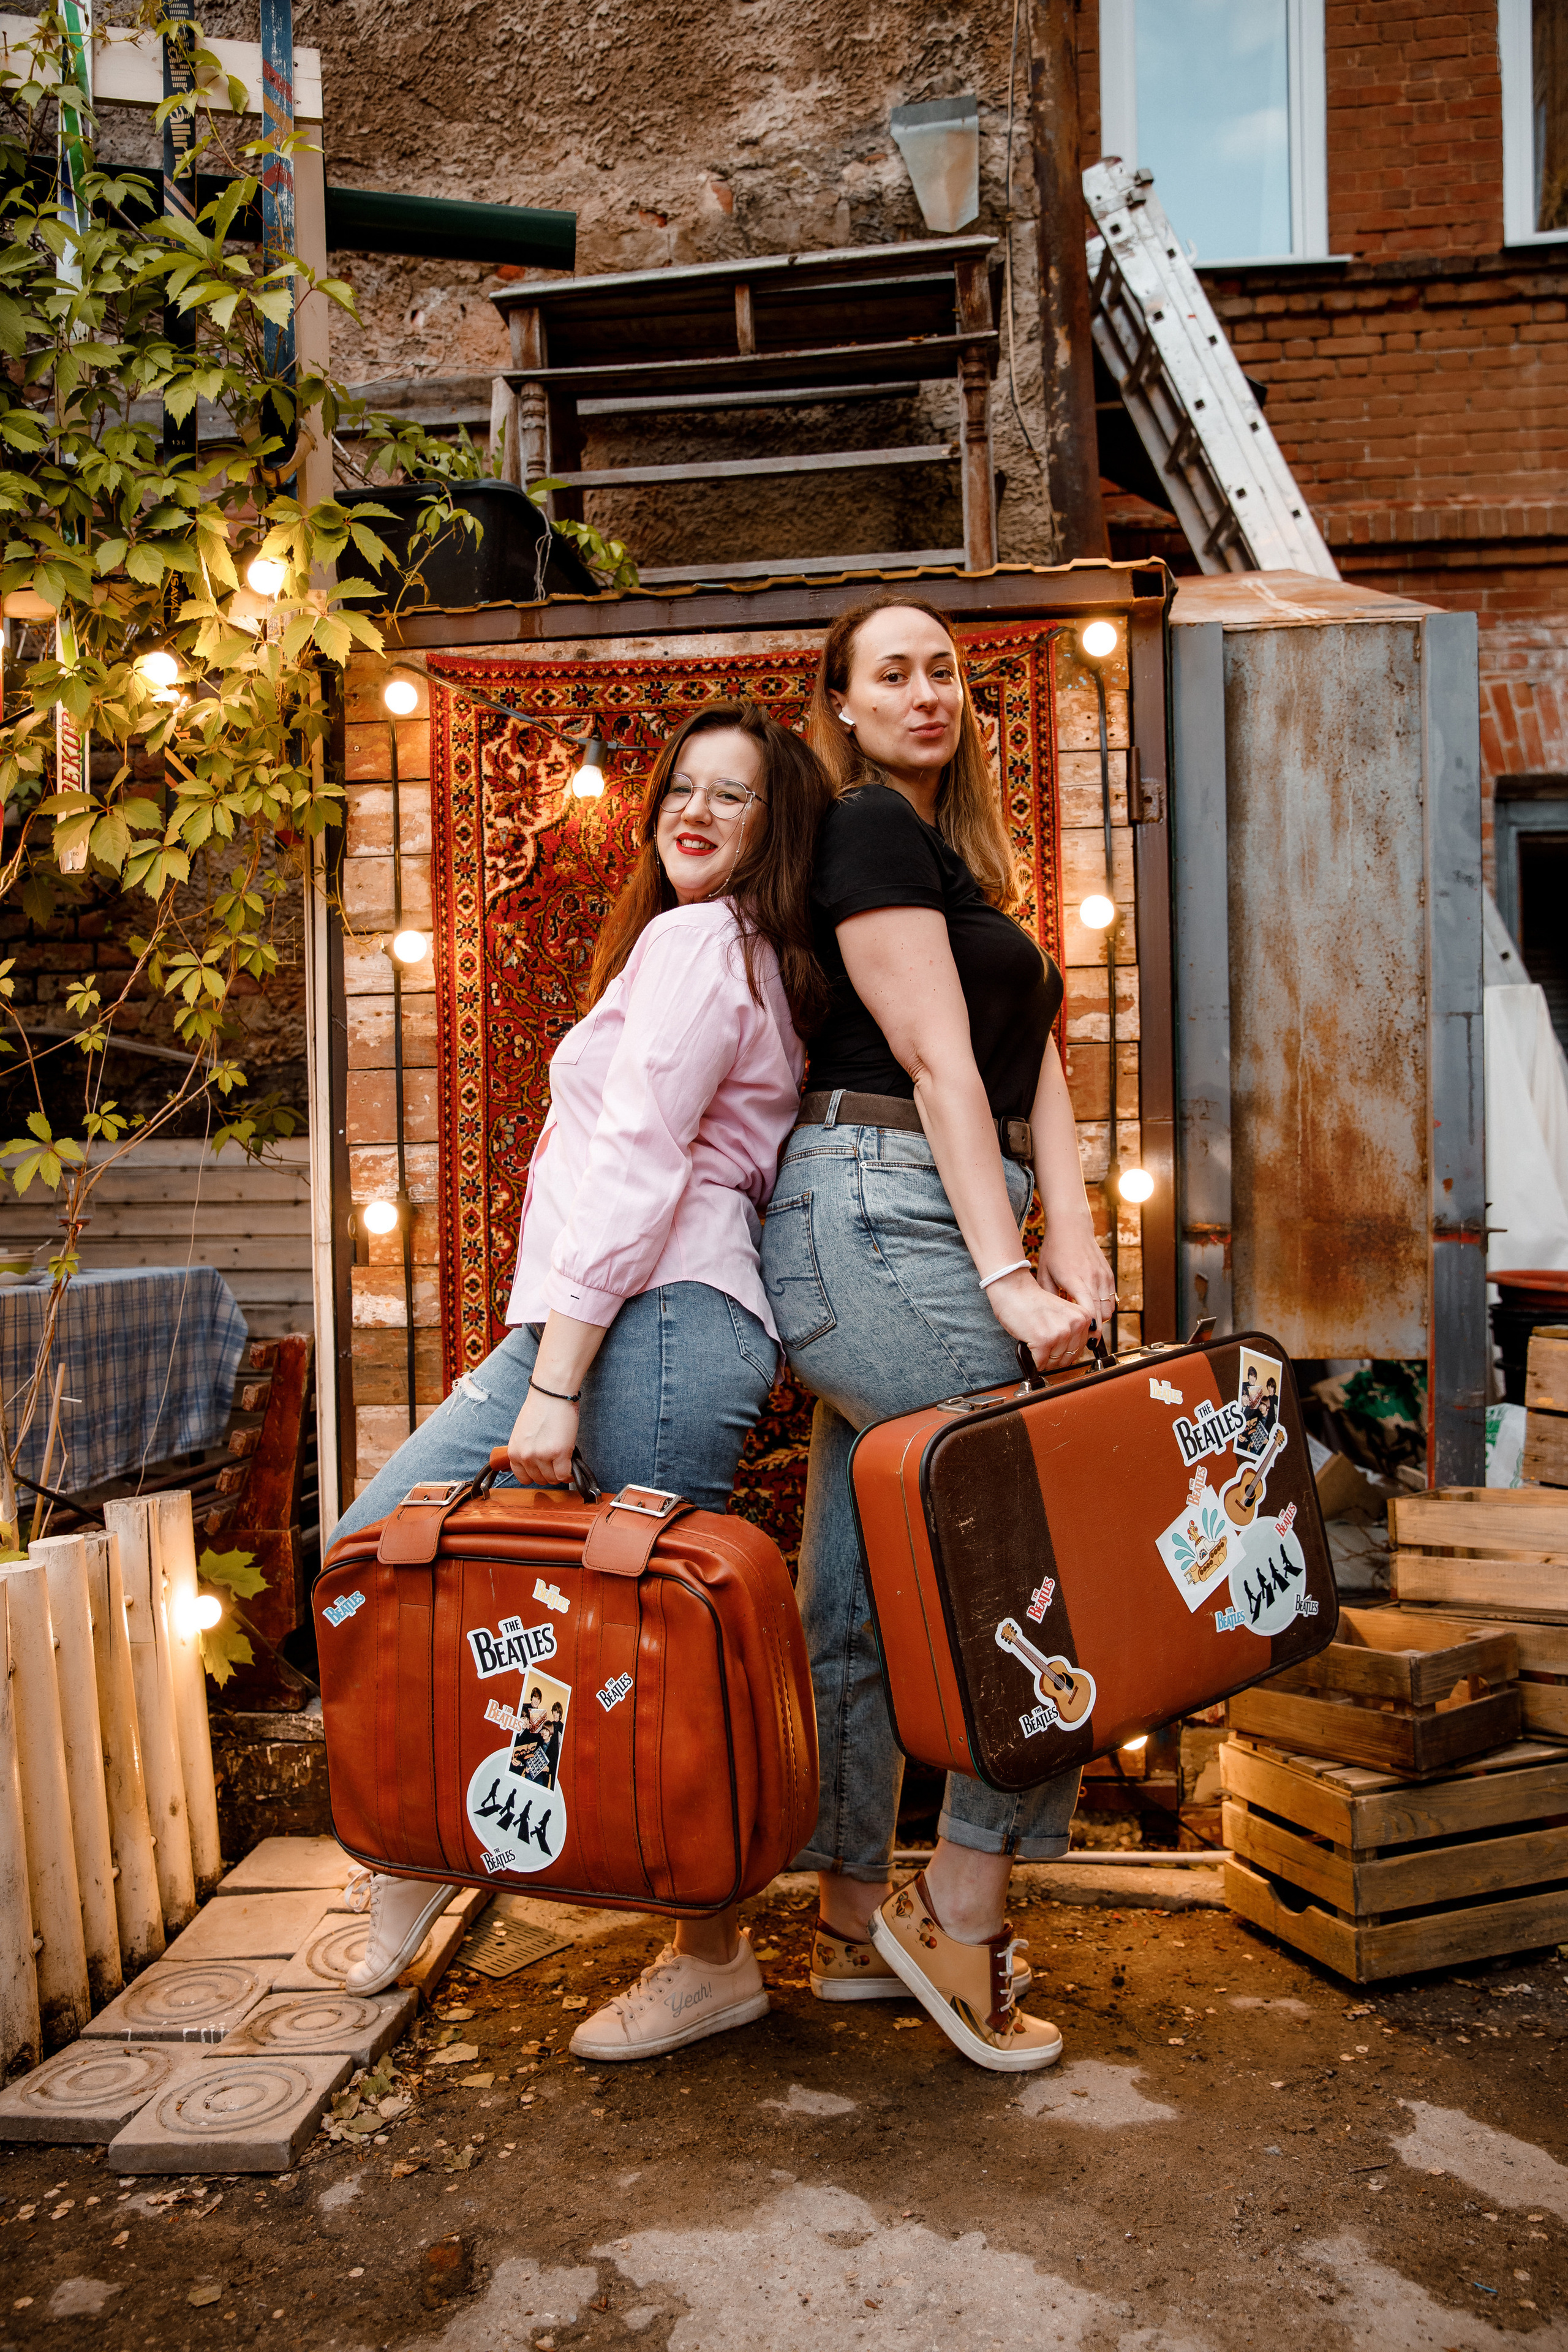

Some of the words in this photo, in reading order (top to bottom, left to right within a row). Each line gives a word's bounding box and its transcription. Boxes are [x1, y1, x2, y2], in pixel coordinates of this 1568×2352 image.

[1198, 1403, 1212, 1418] THE
[1176, 1404, 1243, 1461] BEATLES
[1188, 1466, 1206, 1506] BEATLES
[1275, 1503, 1295, 1537] BEATLES
[325, 1591, 364, 1624] BEATLES
[535, 1580, 569, 1612] BEATLES
[1028, 1578, 1054, 1620] BEATLES
[1295, 1594, 1318, 1615] BEATLES
[503, 1619, 521, 1633] THE
[1217, 1611, 1245, 1630] BEATLES
[472, 1627, 554, 1673] BEATLES
[598, 1674, 631, 1708] BEATLES
[487, 1701, 523, 1732] BEATLES
[1022, 1706, 1058, 1735] BEATLES
[483, 1849, 516, 1872] BEATLES
[664, 1981, 712, 2018] Yeah!
